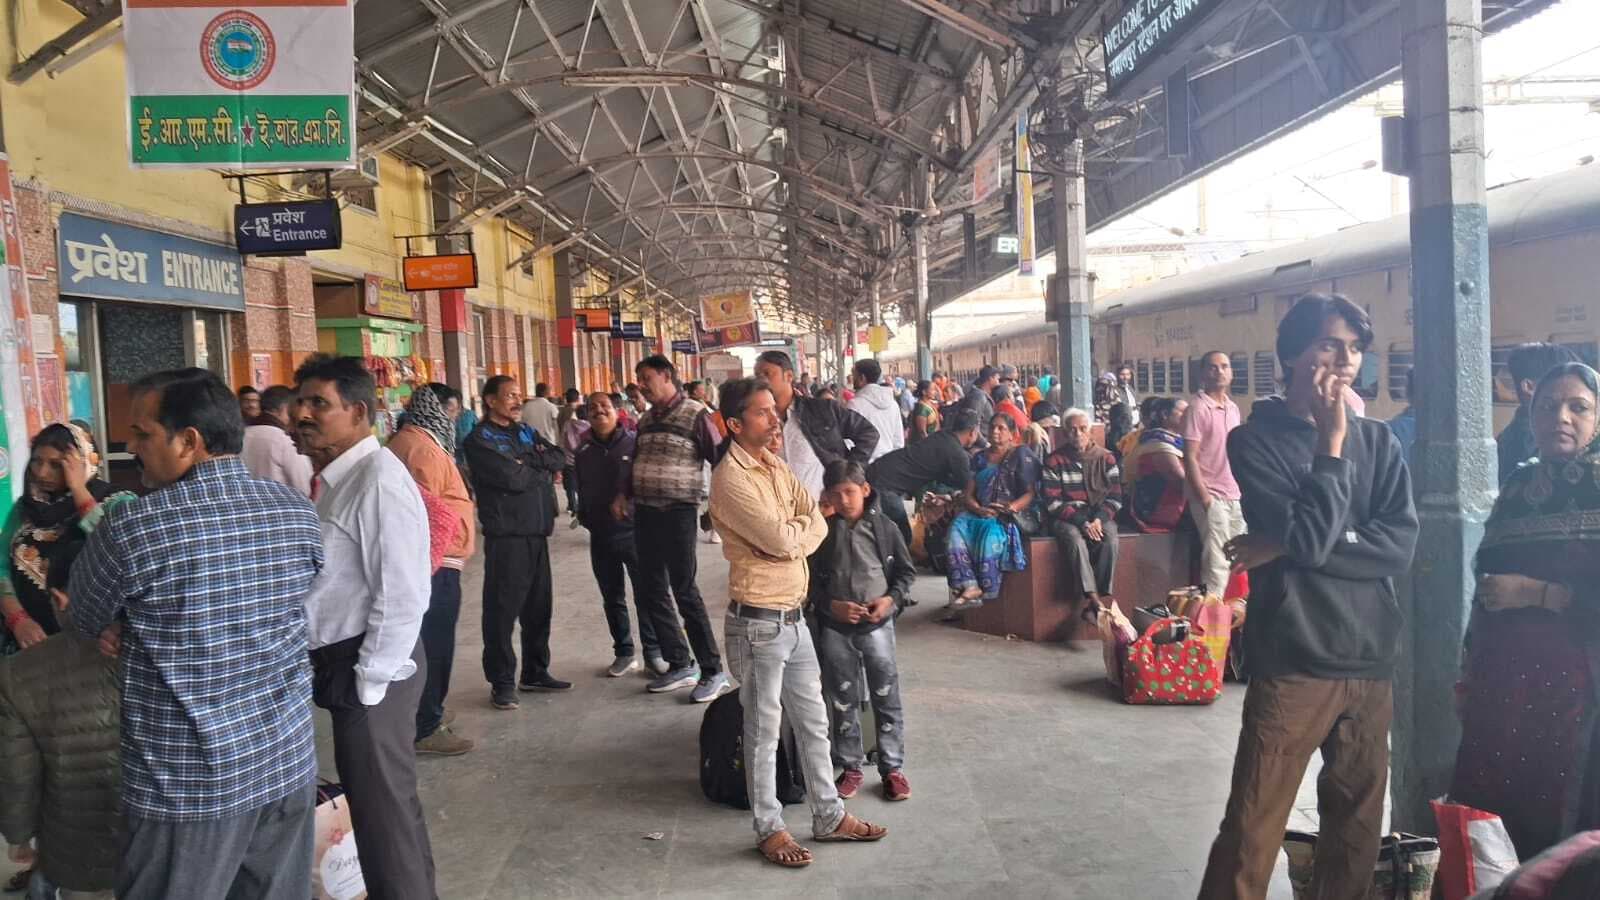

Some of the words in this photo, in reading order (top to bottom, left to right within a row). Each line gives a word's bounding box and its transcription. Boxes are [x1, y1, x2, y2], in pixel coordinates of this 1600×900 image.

[1103, 0, 1145, 57] WELCOME
[1136, 23, 1160, 55] स्टेशन
[1159, 5, 1173, 33] पर
[272, 207, 306, 225] प्रवेश
[272, 228, 328, 242] Entrance
[64, 232, 149, 284] प्रवेश
[161, 249, 240, 296] ENTRANCE
